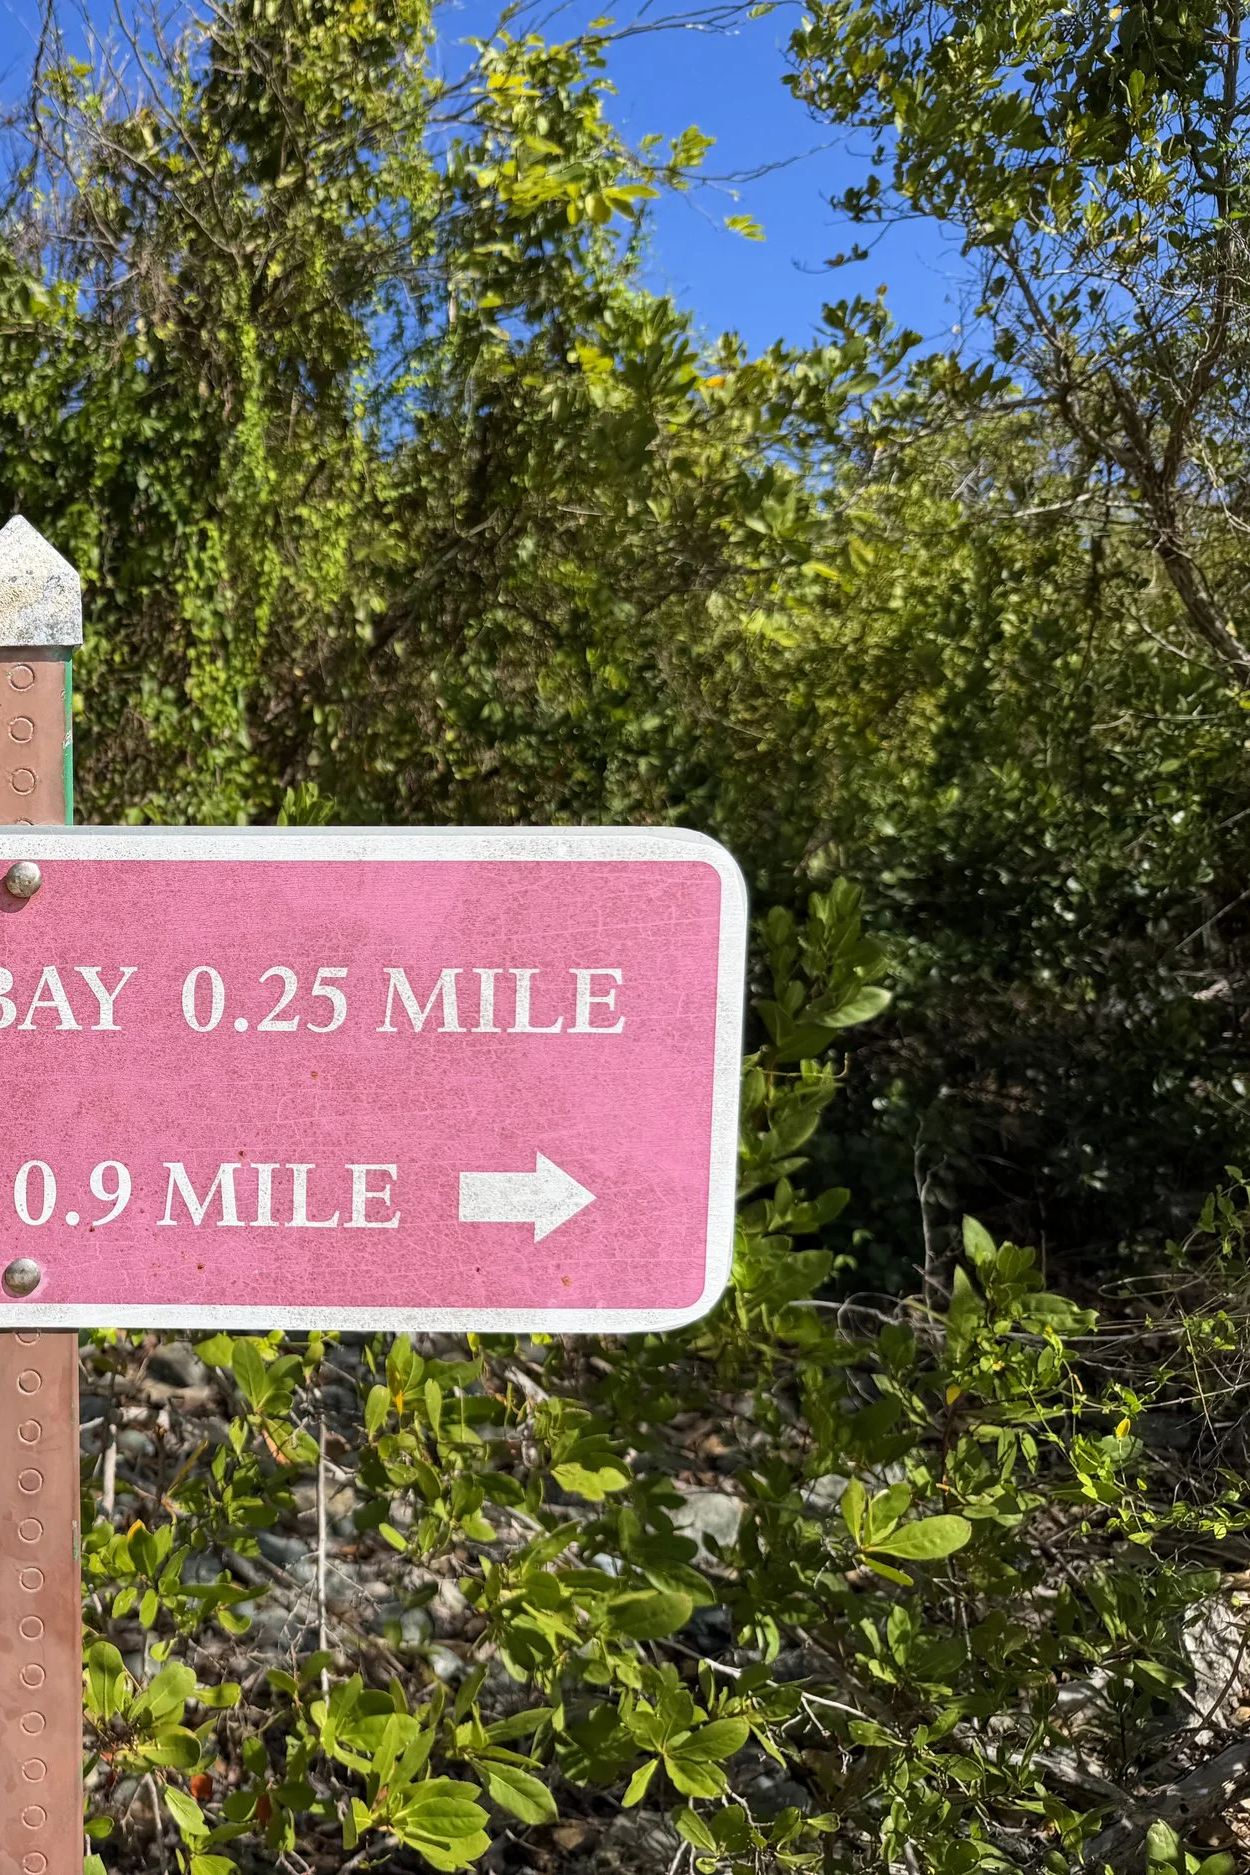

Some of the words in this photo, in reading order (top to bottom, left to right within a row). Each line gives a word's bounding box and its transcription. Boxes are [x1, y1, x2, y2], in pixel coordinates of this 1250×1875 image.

[181, 965, 349, 1033] 0.25
[375, 967, 626, 1034] MILE
[13, 1159, 132, 1227] 0.9
[156, 1162, 401, 1229] MILE
